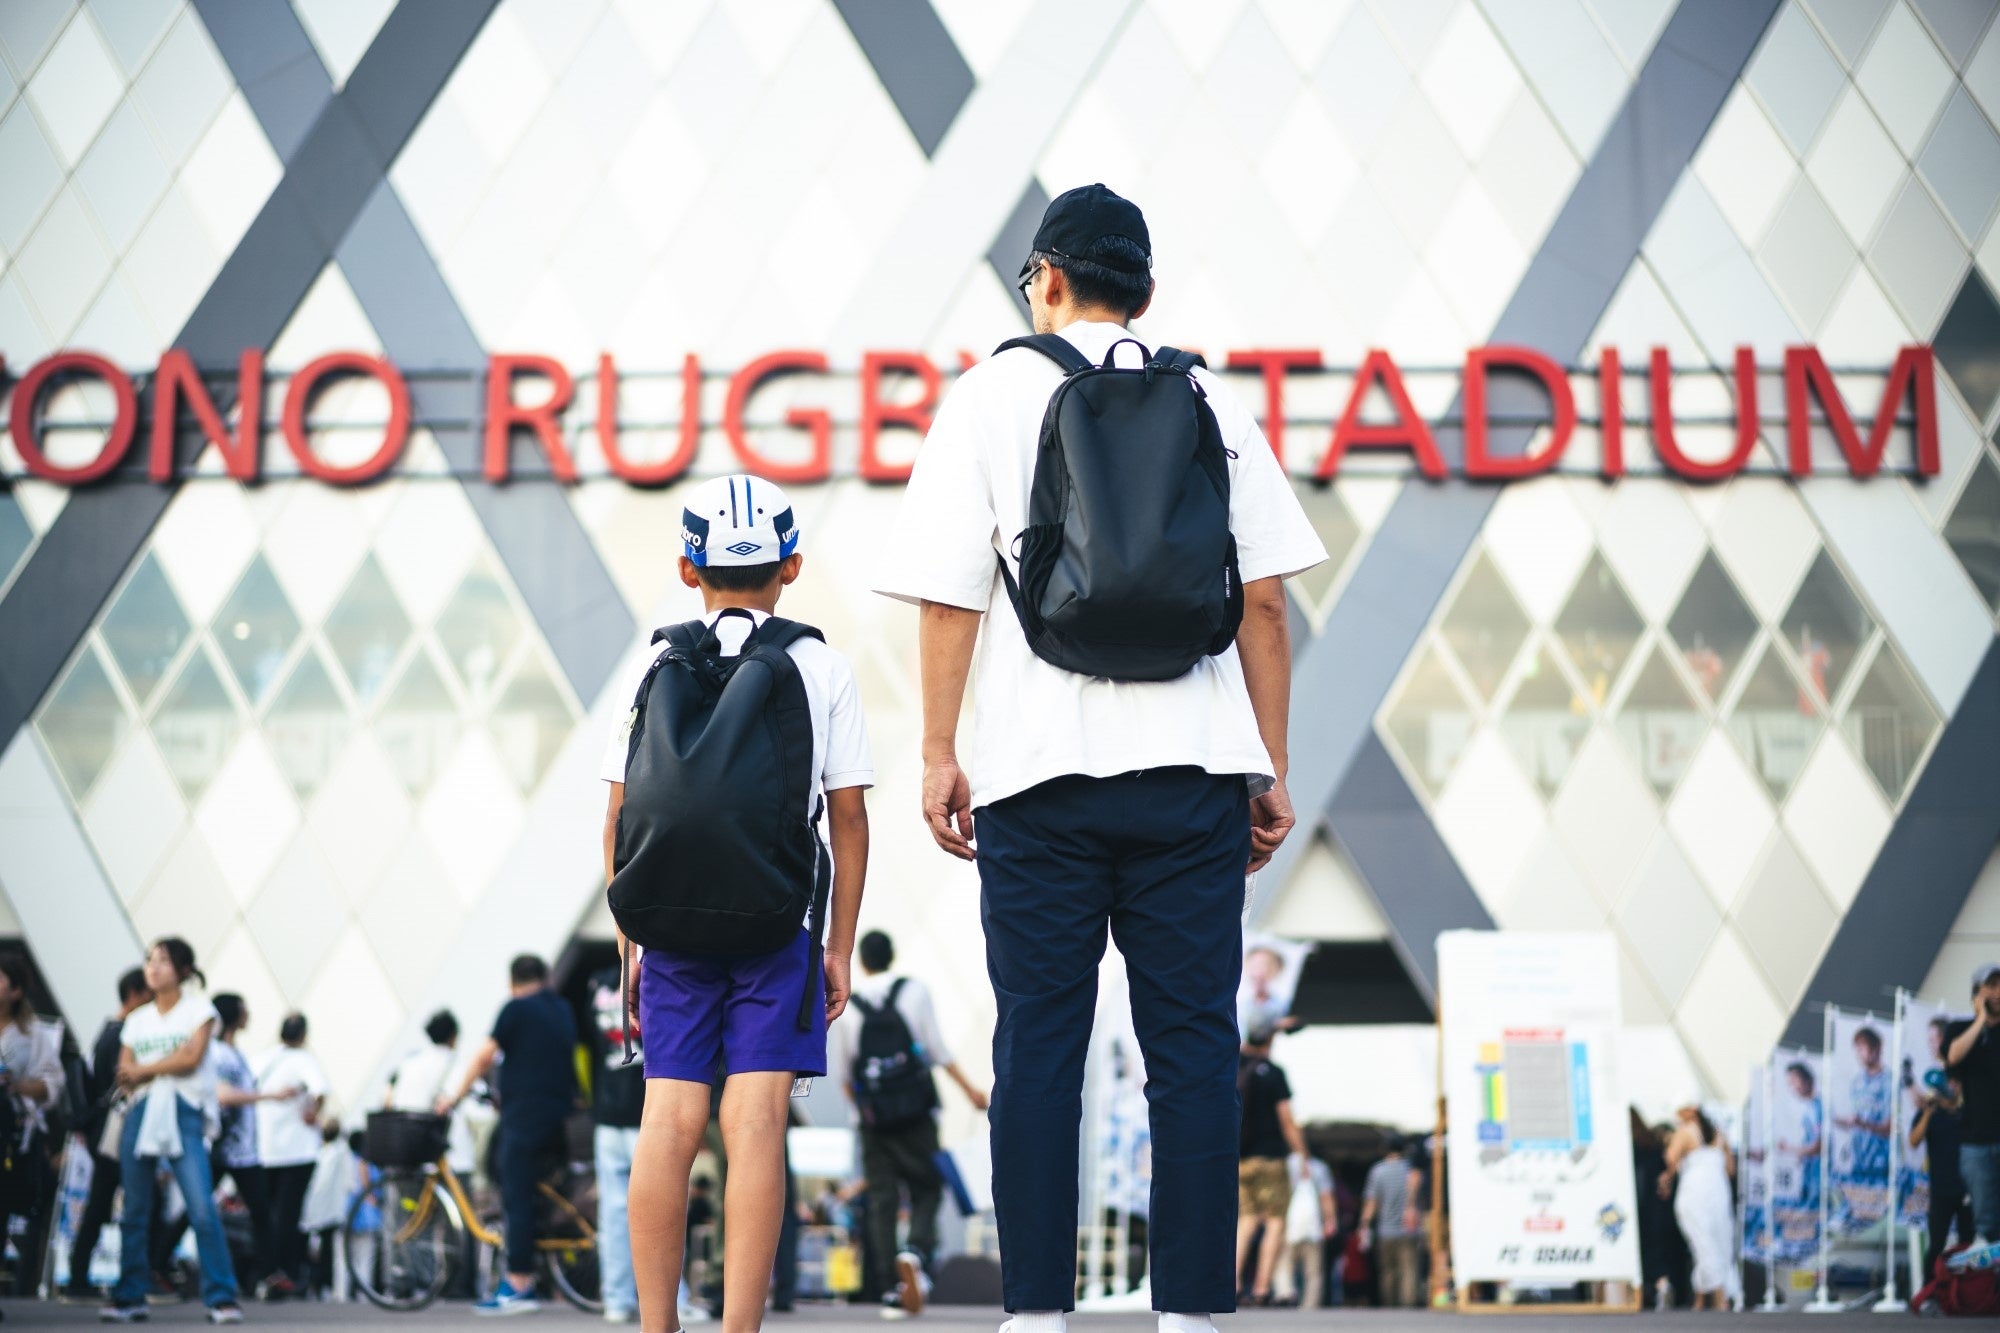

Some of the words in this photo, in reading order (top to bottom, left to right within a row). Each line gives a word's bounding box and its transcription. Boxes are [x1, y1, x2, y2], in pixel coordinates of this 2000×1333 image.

[0, 349, 412, 483] ONO
[482, 349, 980, 483] RUGB
[1176, 344, 1941, 480] TADIUM
[681, 525, 702, 547] bro
